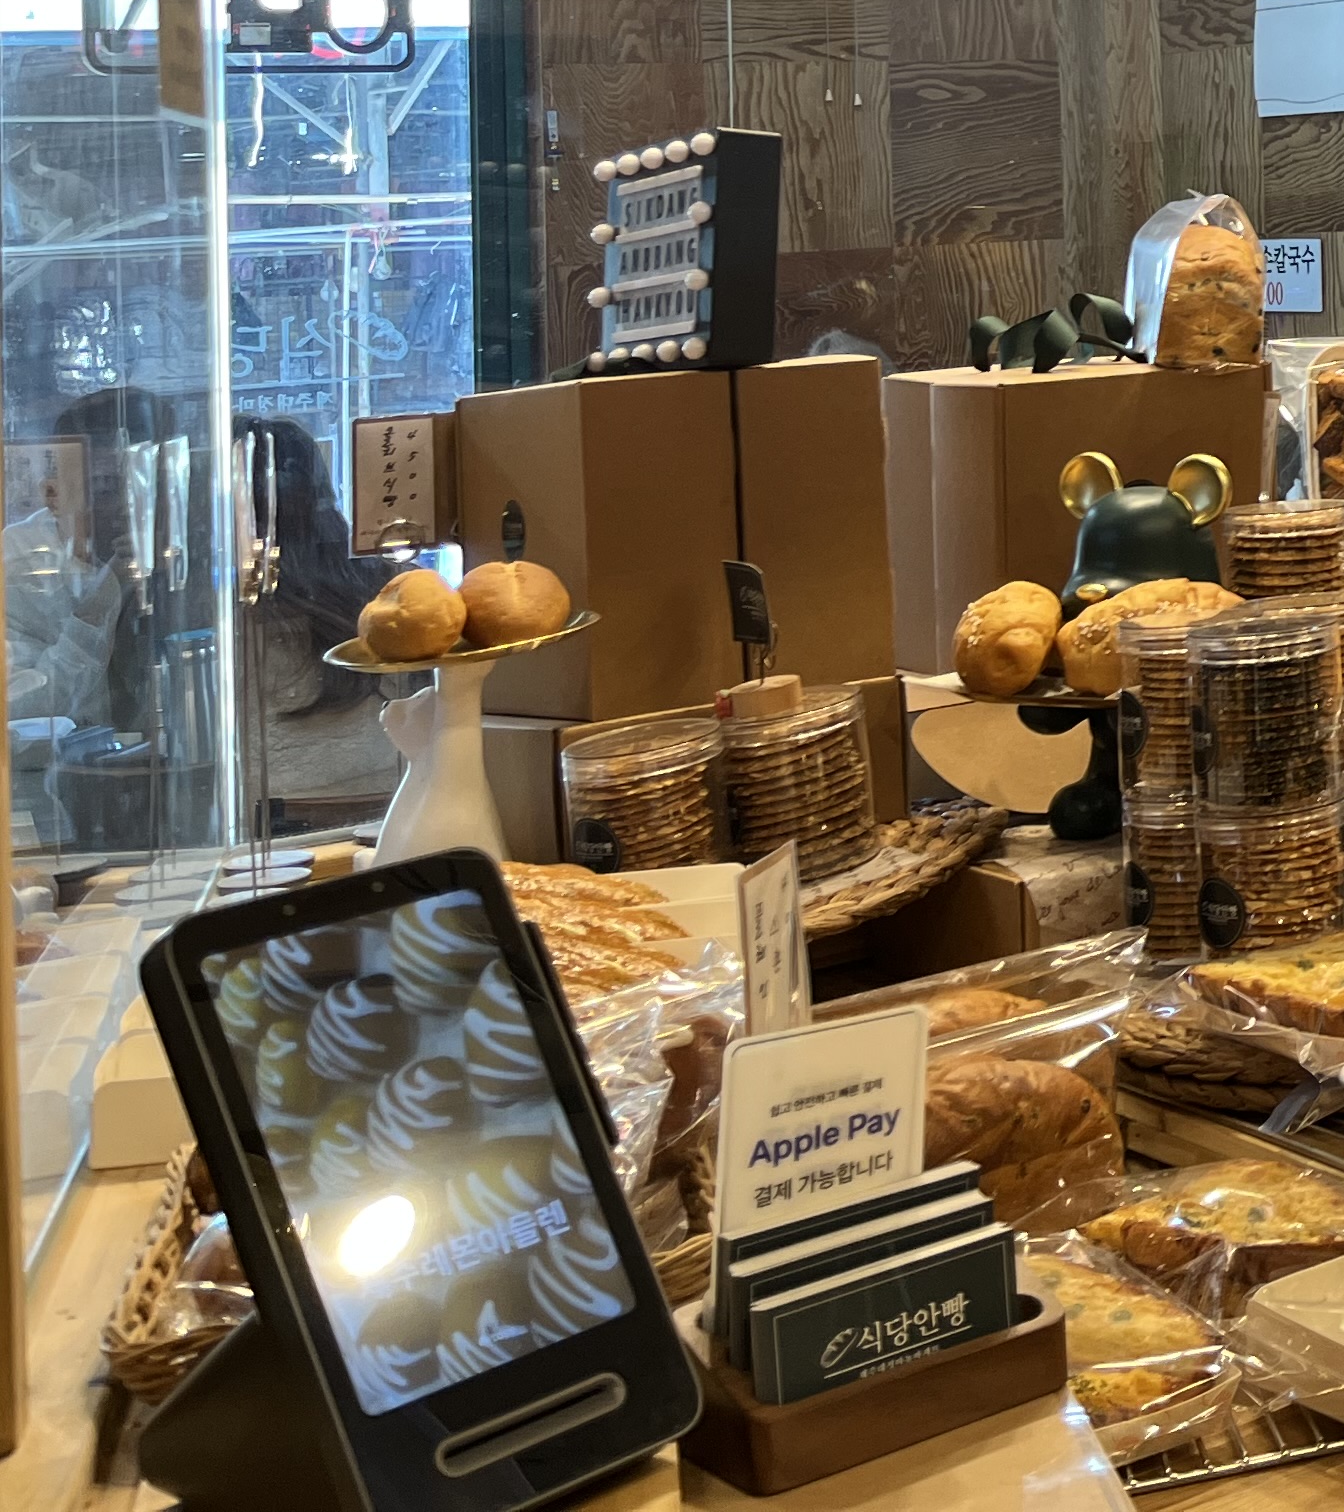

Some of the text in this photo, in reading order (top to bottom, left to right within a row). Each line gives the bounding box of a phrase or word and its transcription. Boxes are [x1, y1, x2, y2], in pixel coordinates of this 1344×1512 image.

[407, 430, 419, 500] 4500
[748, 1107, 902, 1170] Apple Pay
[753, 1150, 895, 1210] 결제 가능합니다
[857, 1291, 970, 1356] 식당안빵
